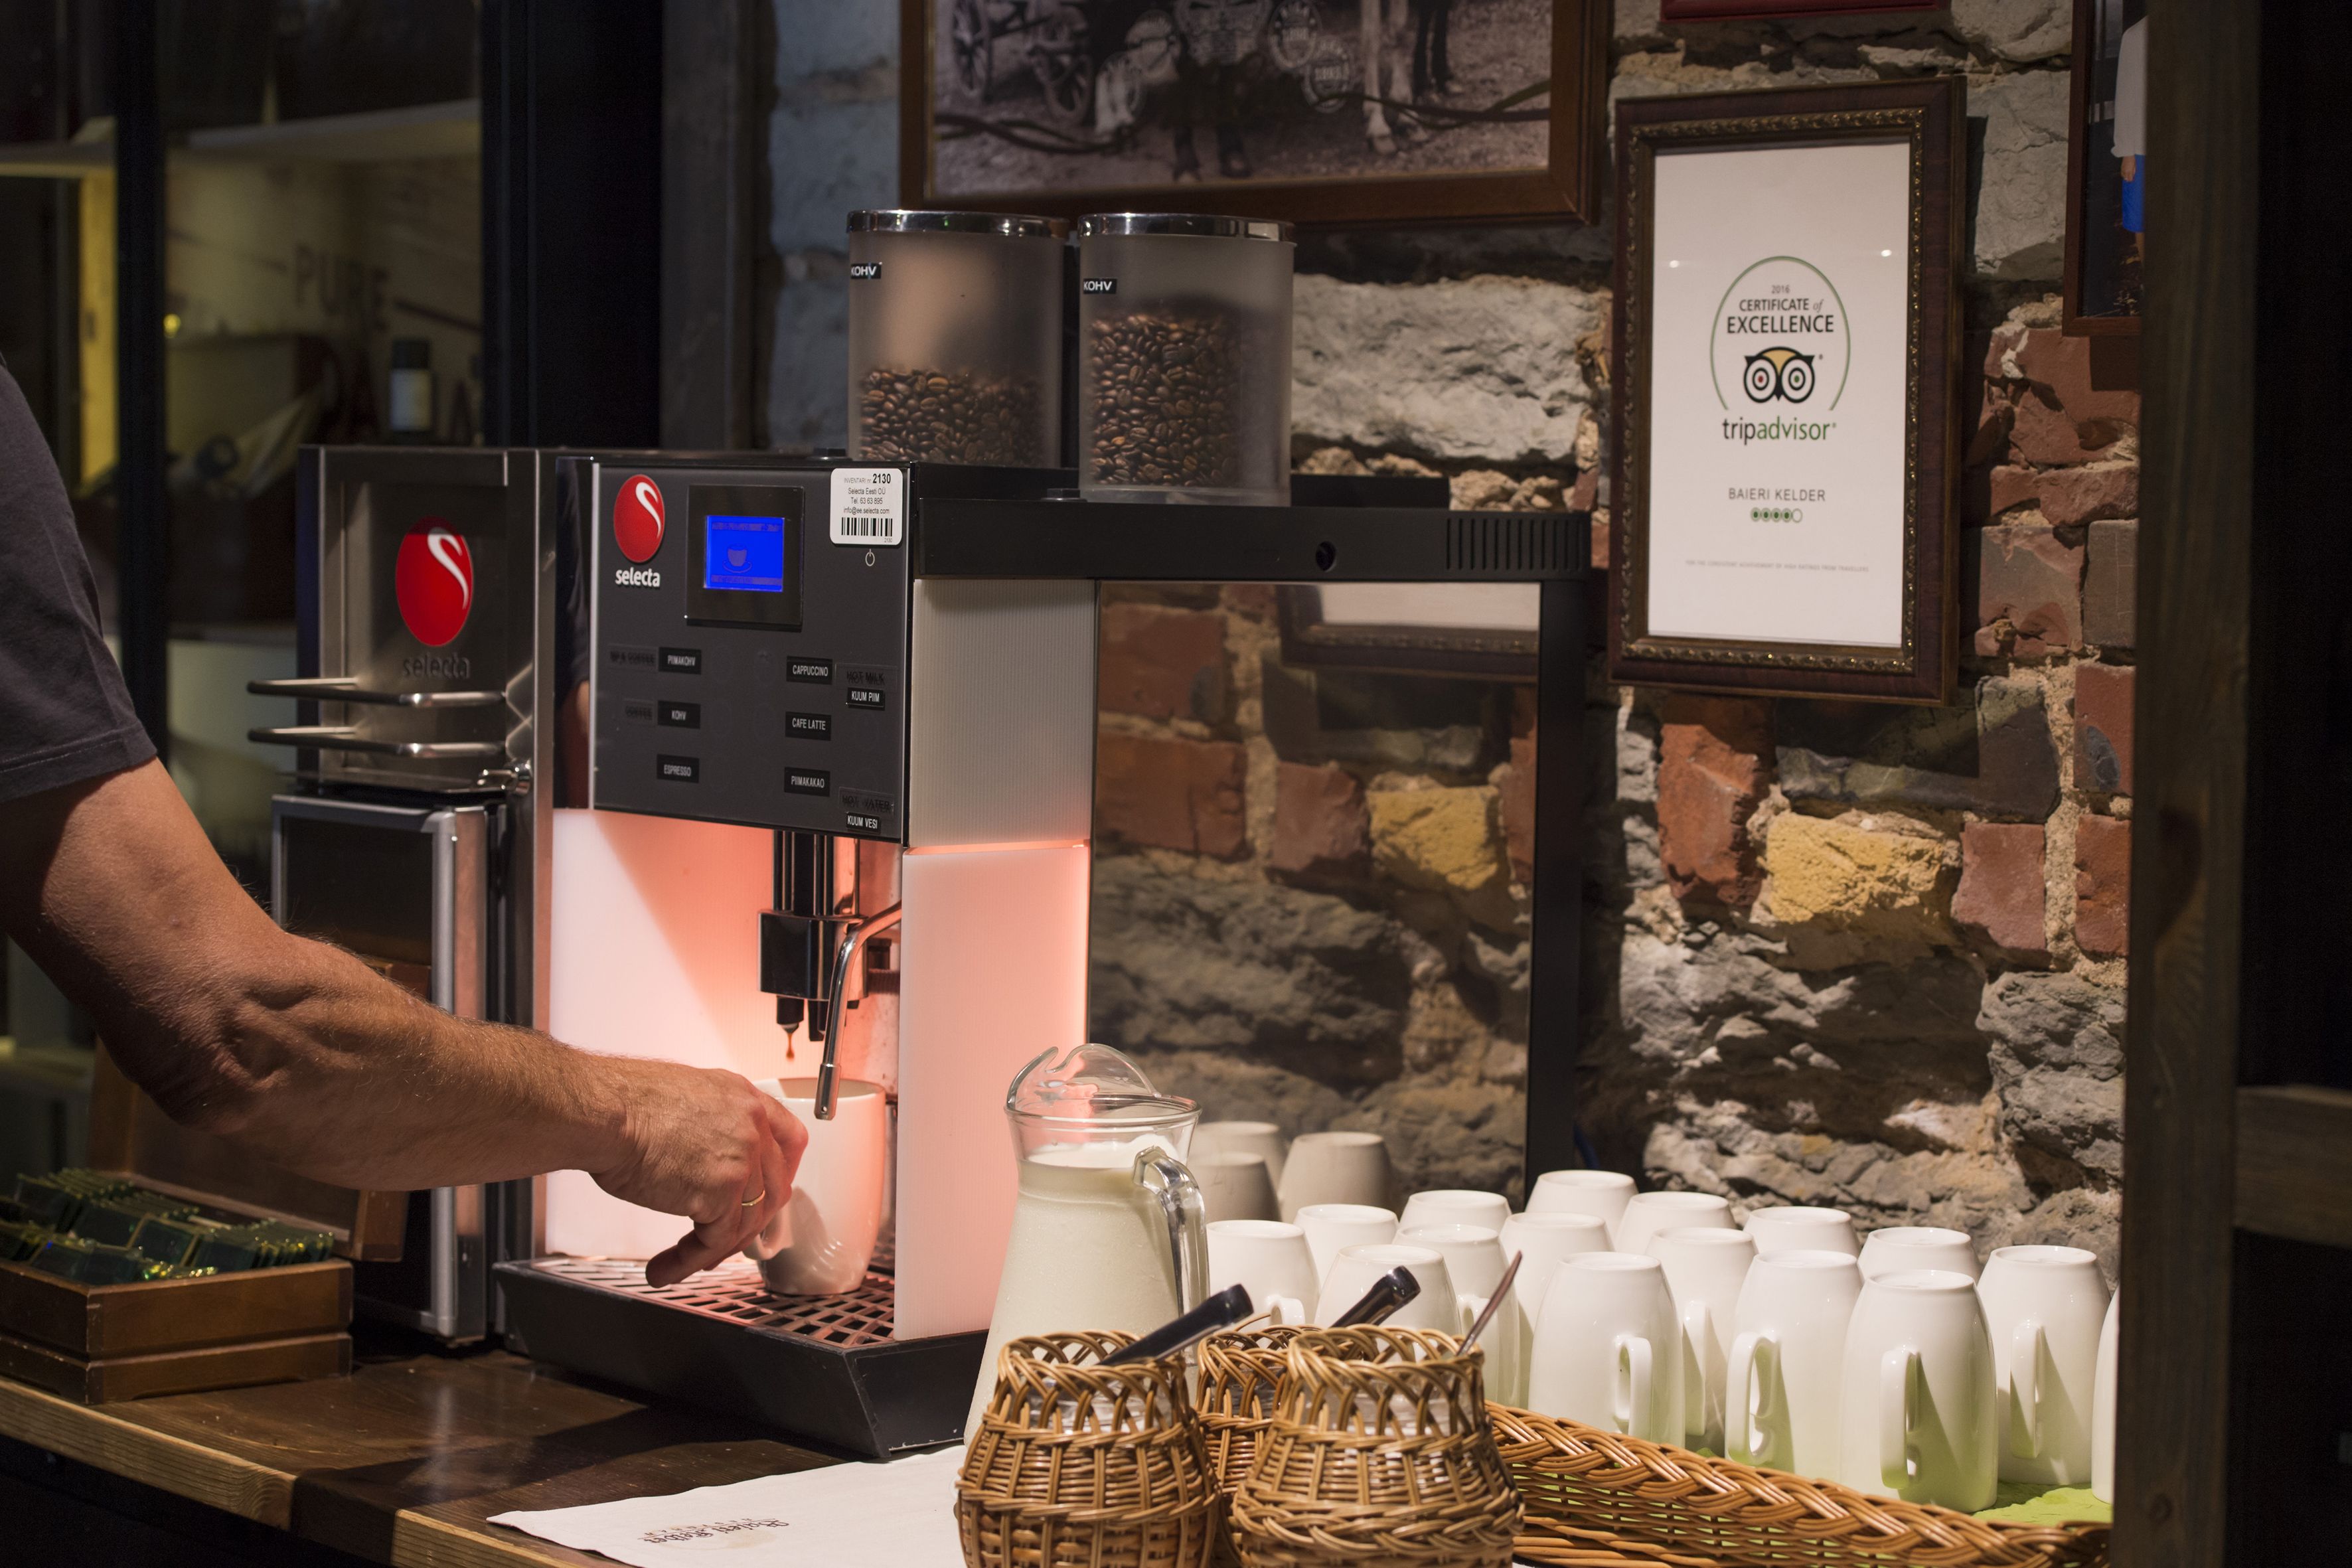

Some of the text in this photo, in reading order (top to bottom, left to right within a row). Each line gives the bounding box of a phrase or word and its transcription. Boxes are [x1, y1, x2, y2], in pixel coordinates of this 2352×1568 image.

[1083, 281, 1113, 291] KOHV
[1771, 284, 1790, 294] 2016
[1739, 299, 1824, 314] CERTIFICATE of
[1727, 315, 1834, 333] EXCELLENCE
[1722, 415, 1831, 445] tripadvisor
[872, 473, 891, 484] 2130
[1728, 487, 1826, 501] BAIERI KELDER
[615, 566, 661, 588] selecta
[402, 653, 471, 679] selecta
[667, 655, 696, 666] PIIMAKOHV
[793, 665, 828, 676] CAPPUCCINO
[851, 690, 880, 703] KUUM PIIM
[671, 710, 686, 721] KOHV
[792, 717, 826, 730] CAFE LATTE
[664, 764, 692, 777] ESPRESSO
[791, 775, 824, 789] PIIMAKAKAO
[847, 815, 878, 829] KUUM VESI
